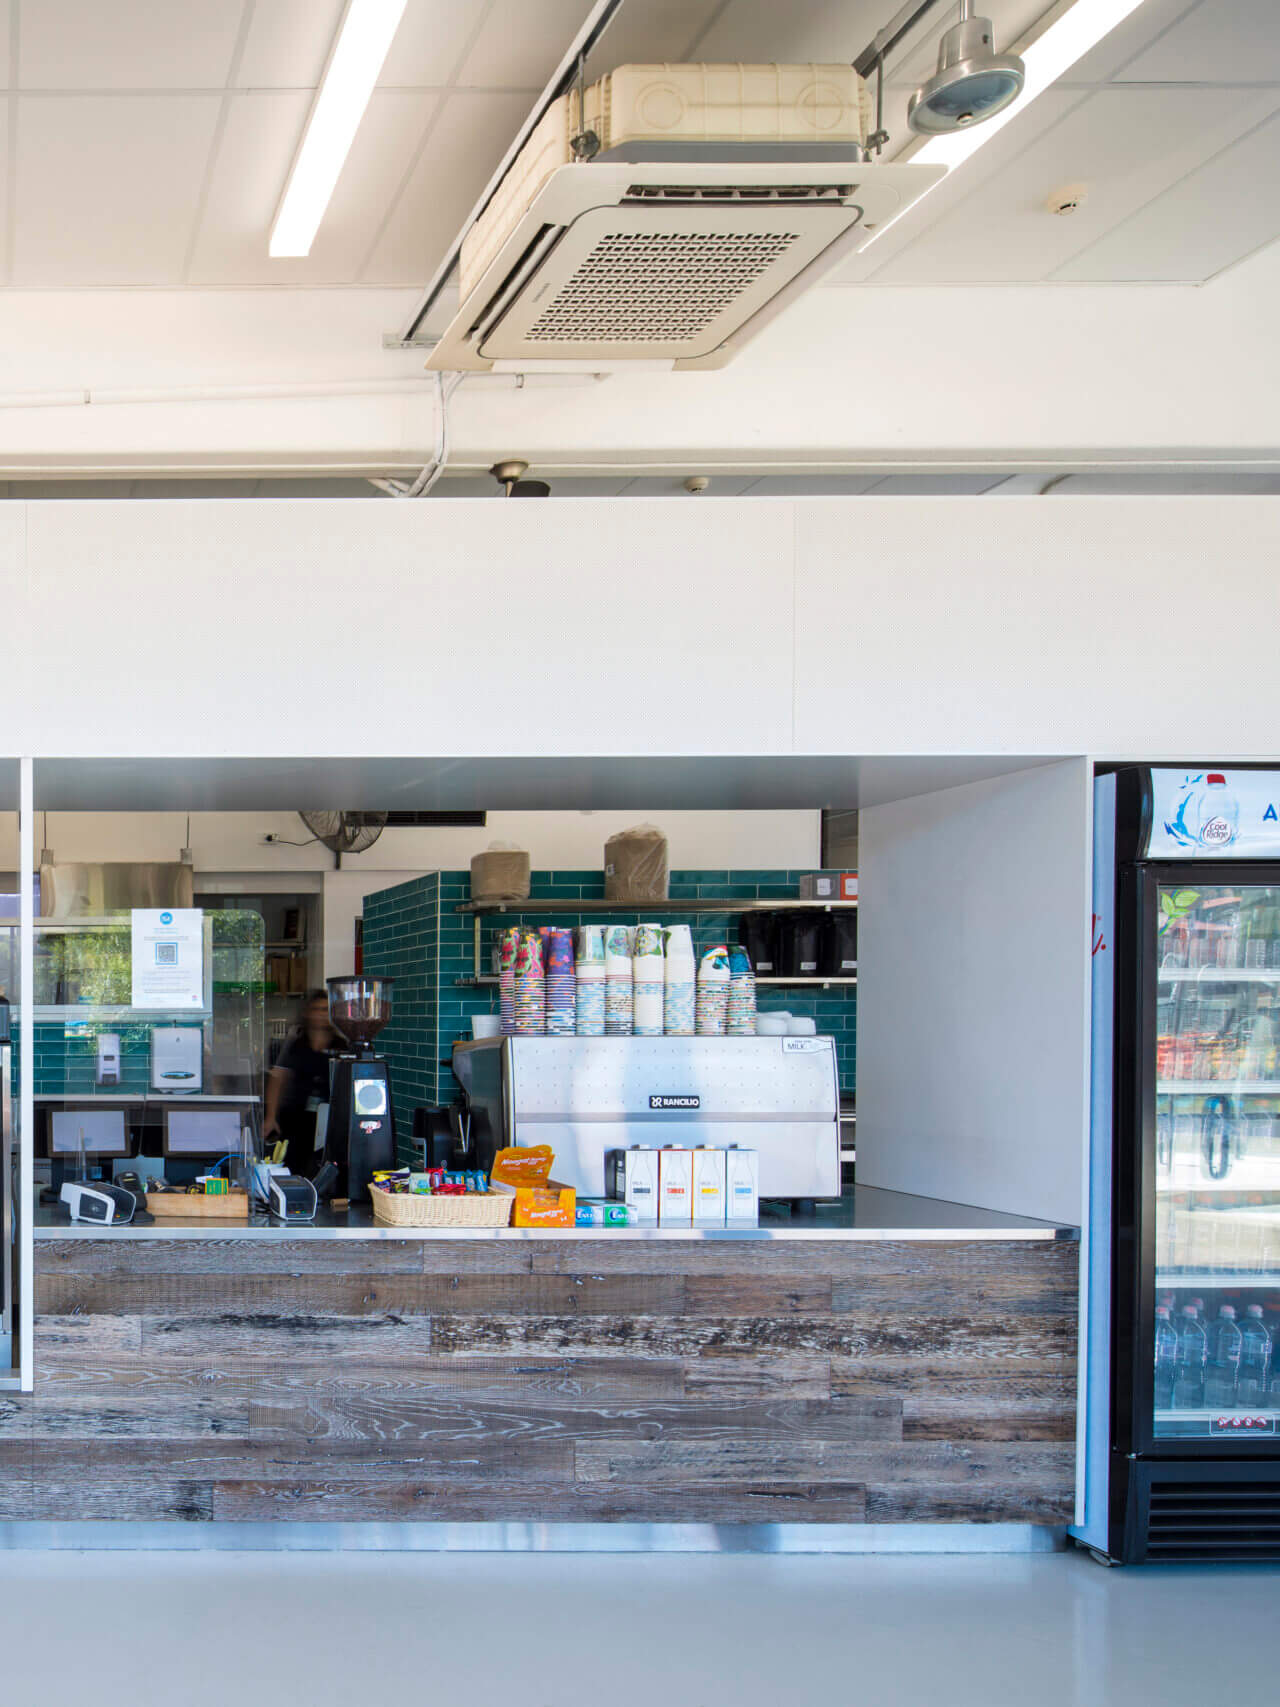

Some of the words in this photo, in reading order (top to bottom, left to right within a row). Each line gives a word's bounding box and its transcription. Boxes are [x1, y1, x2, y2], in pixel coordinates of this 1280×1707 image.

[1263, 803, 1280, 821] A
[1210, 823, 1227, 831] Cool
[1206, 830, 1228, 841] Ridge
[663, 1098, 699, 1106] RANCILIO
